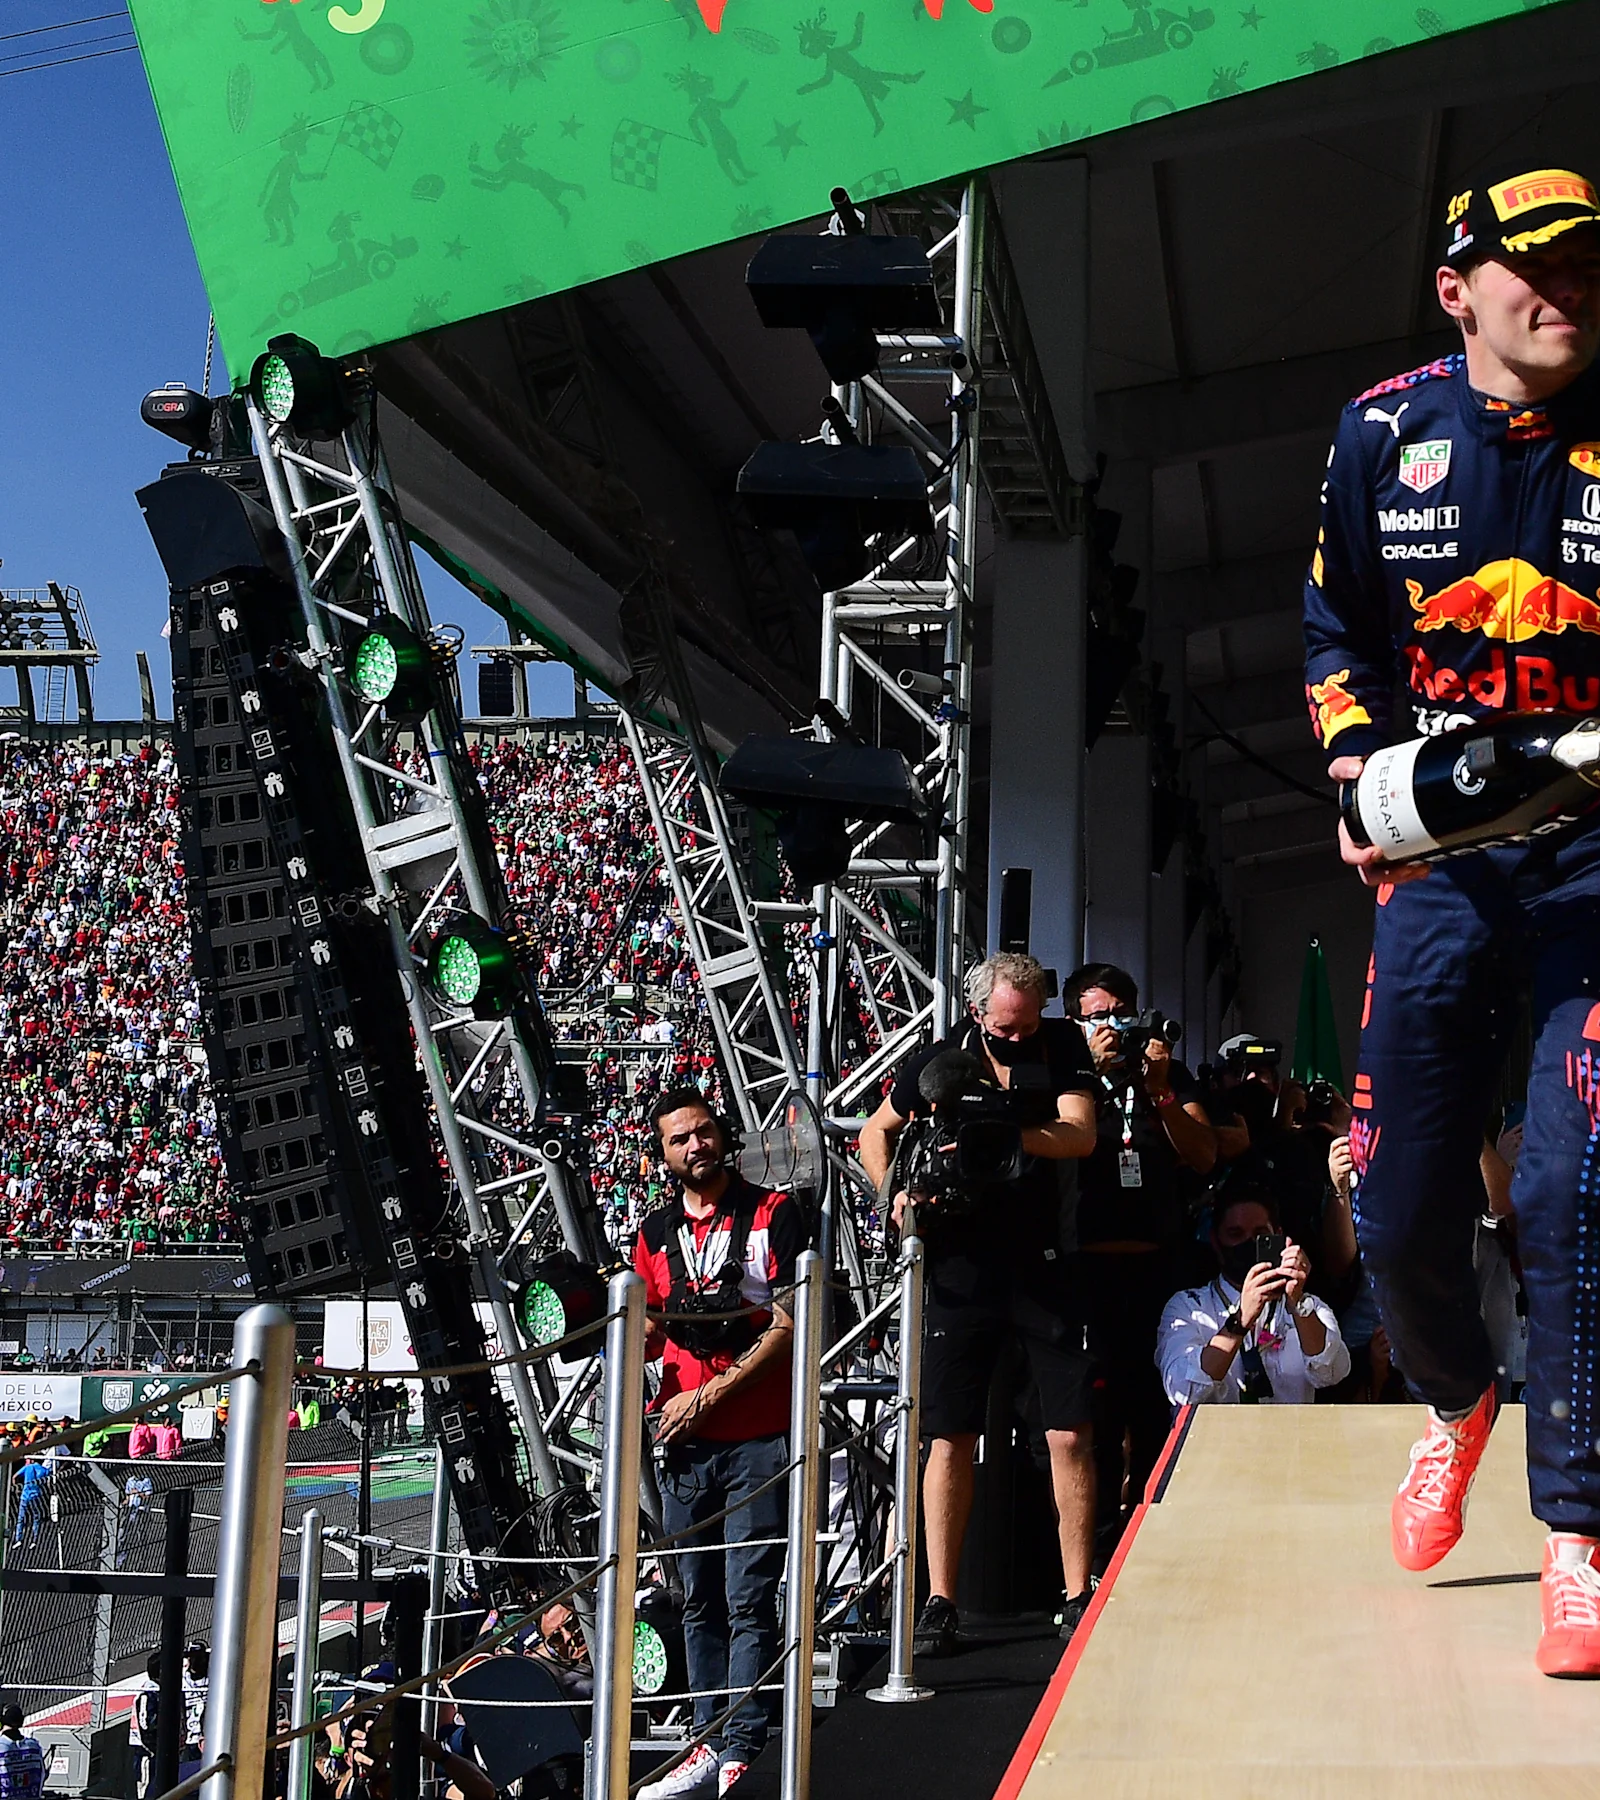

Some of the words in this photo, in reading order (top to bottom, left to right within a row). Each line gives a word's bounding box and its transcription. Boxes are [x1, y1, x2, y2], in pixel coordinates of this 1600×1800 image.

[1446, 189, 1472, 225] 1ST
[151, 402, 185, 412] LOGRA
[1404, 444, 1447, 463] TAG
[1381, 541, 1458, 560] ORACLE
[1376, 753, 1405, 845] FERRARI
[80, 1263, 131, 1290] VERSTAPPEN
[5, 1384, 26, 1395] DE
[33, 1384, 53, 1395] LA
